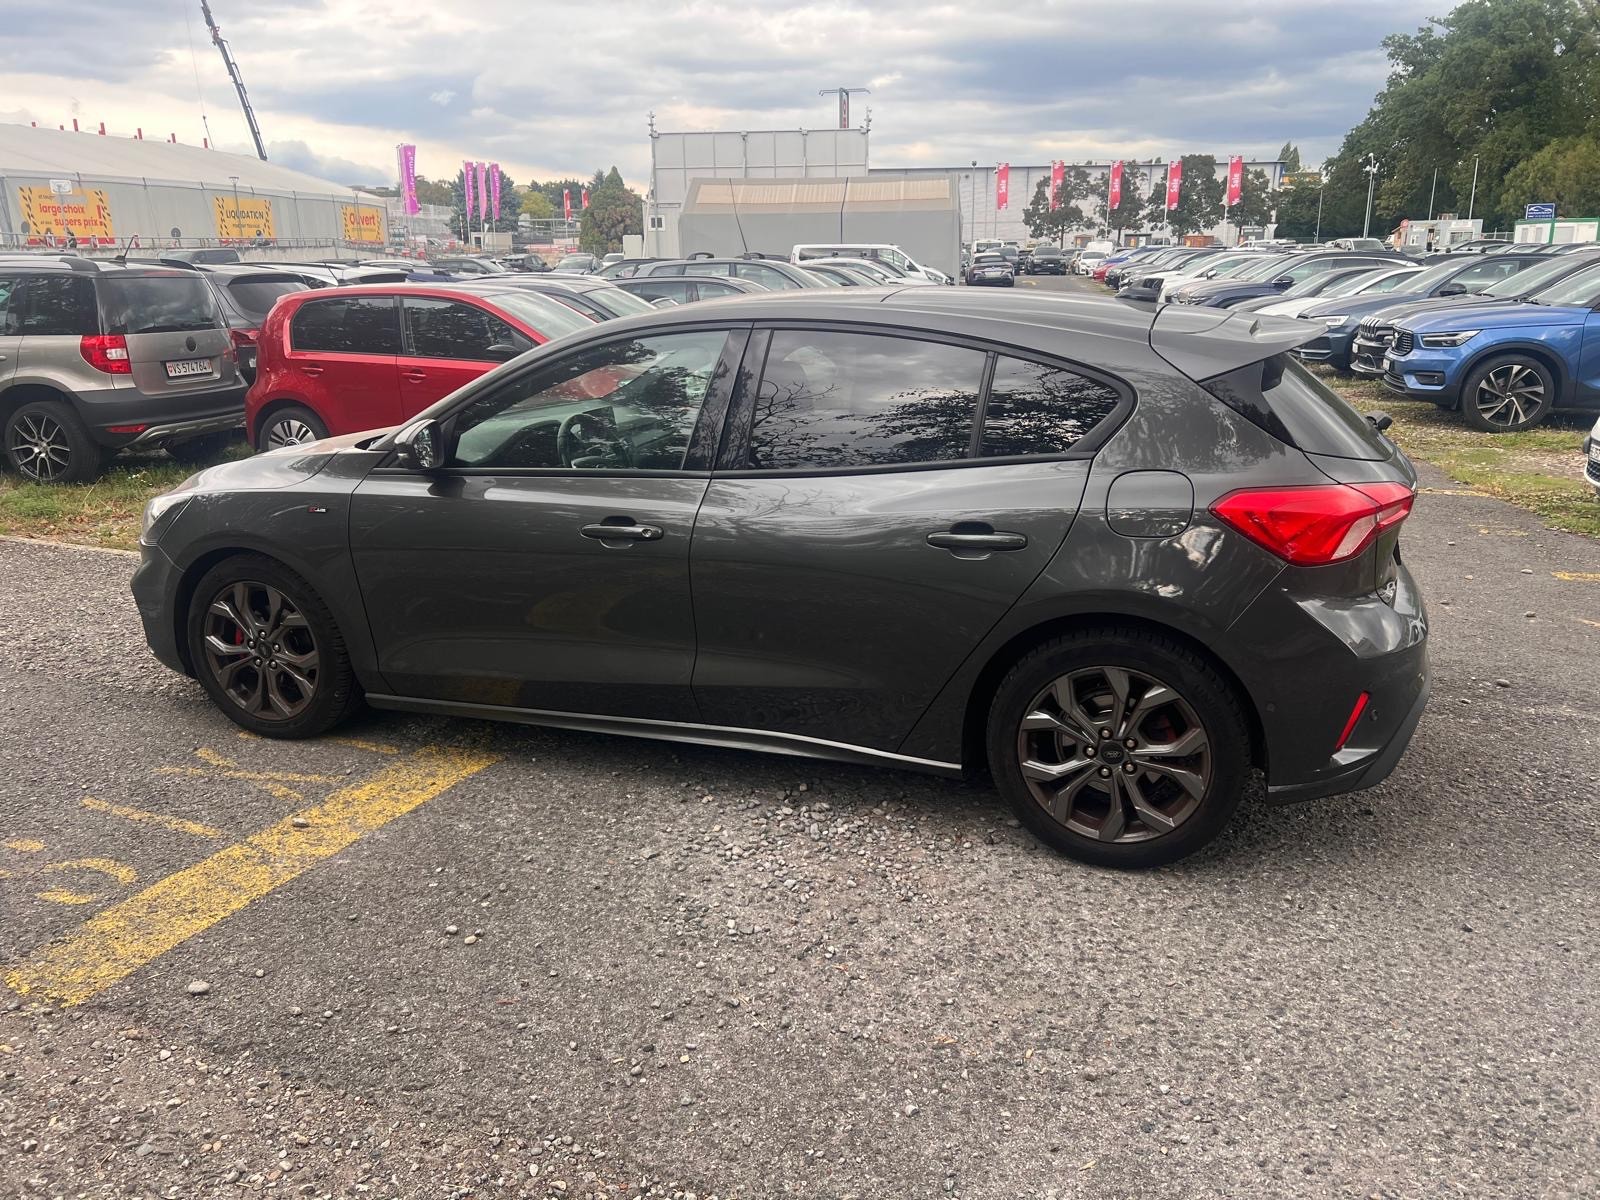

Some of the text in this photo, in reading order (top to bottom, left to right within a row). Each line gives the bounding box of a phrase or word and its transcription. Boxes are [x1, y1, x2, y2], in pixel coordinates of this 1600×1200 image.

[1112, 178, 1120, 193] Sale
[1170, 178, 1178, 193] Sale
[1231, 173, 1240, 188] Sale
[39, 203, 85, 216] large choix
[226, 210, 264, 220] LIQUIDATION
[349, 212, 376, 225] Ouvert
[172, 361, 207, 374] VS 574764
